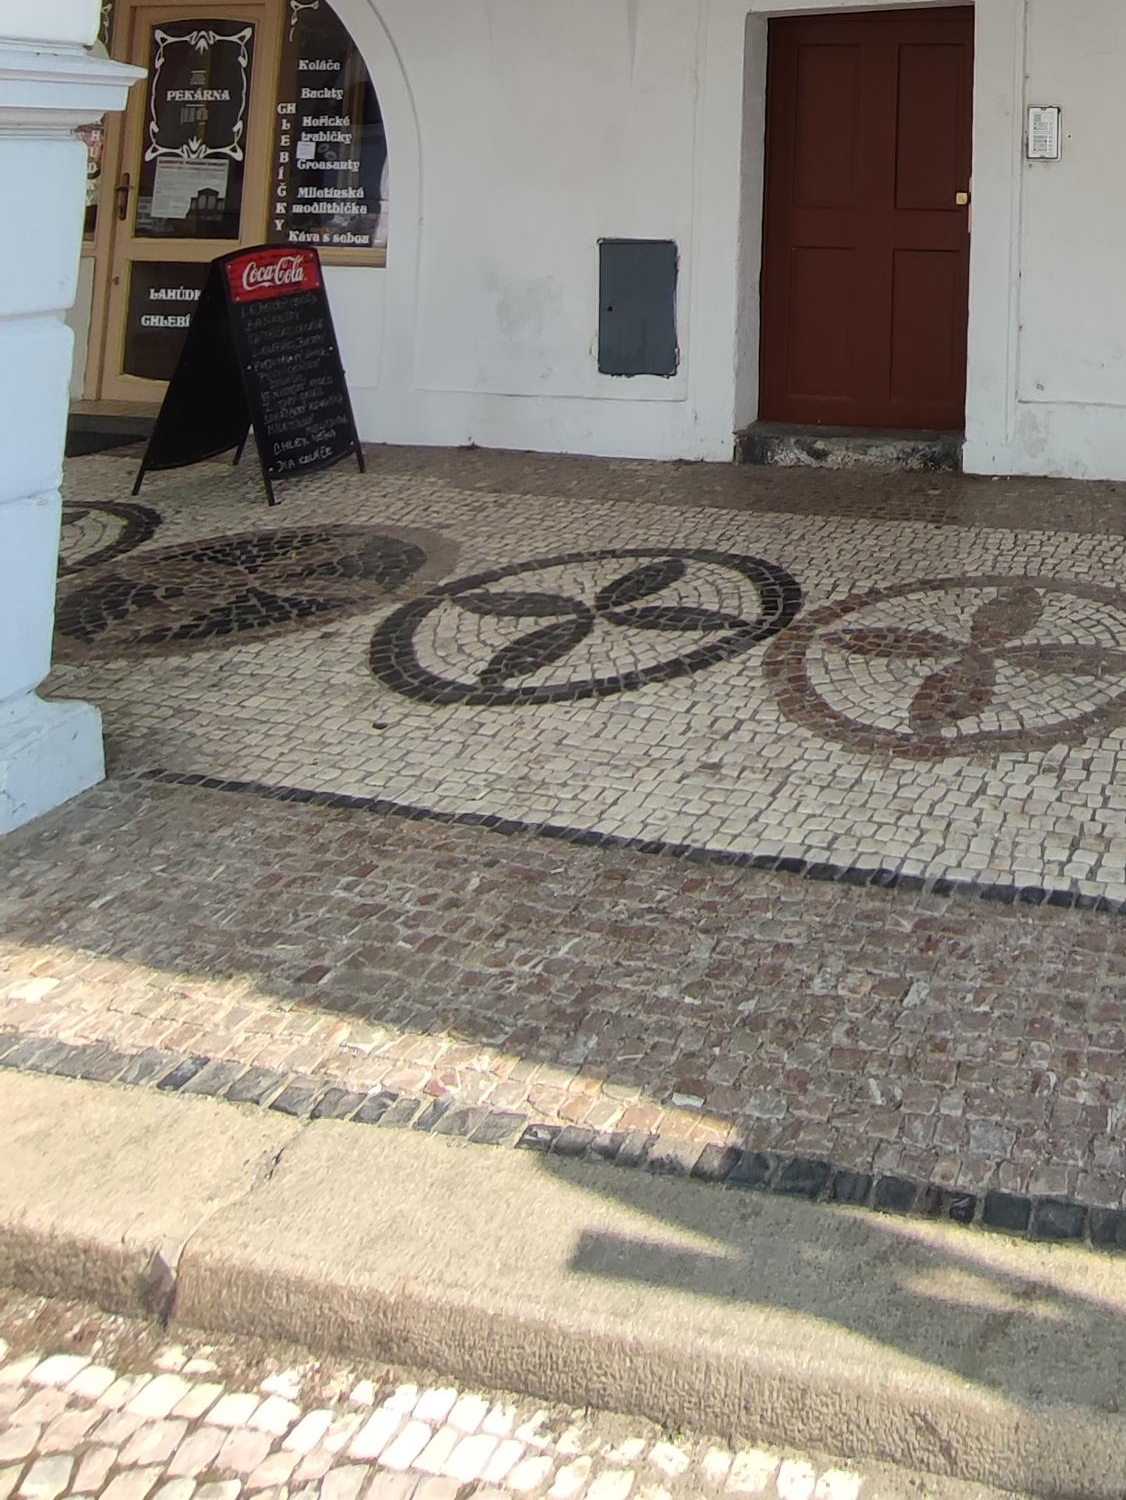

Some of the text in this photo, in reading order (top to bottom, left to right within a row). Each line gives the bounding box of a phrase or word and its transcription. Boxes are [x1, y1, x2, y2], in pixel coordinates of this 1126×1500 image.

[298, 59, 342, 71] Koláče
[166, 87, 231, 101] PEKÁRNA
[301, 87, 344, 101] Buchty
[302, 115, 351, 127] Hořické
[301, 131, 353, 145] trubičky
[297, 187, 365, 199] Miletínská
[292, 202, 368, 215] modlitbička
[288, 230, 370, 245] Káva s sebou
[242, 255, 305, 291] Coca-Cola
